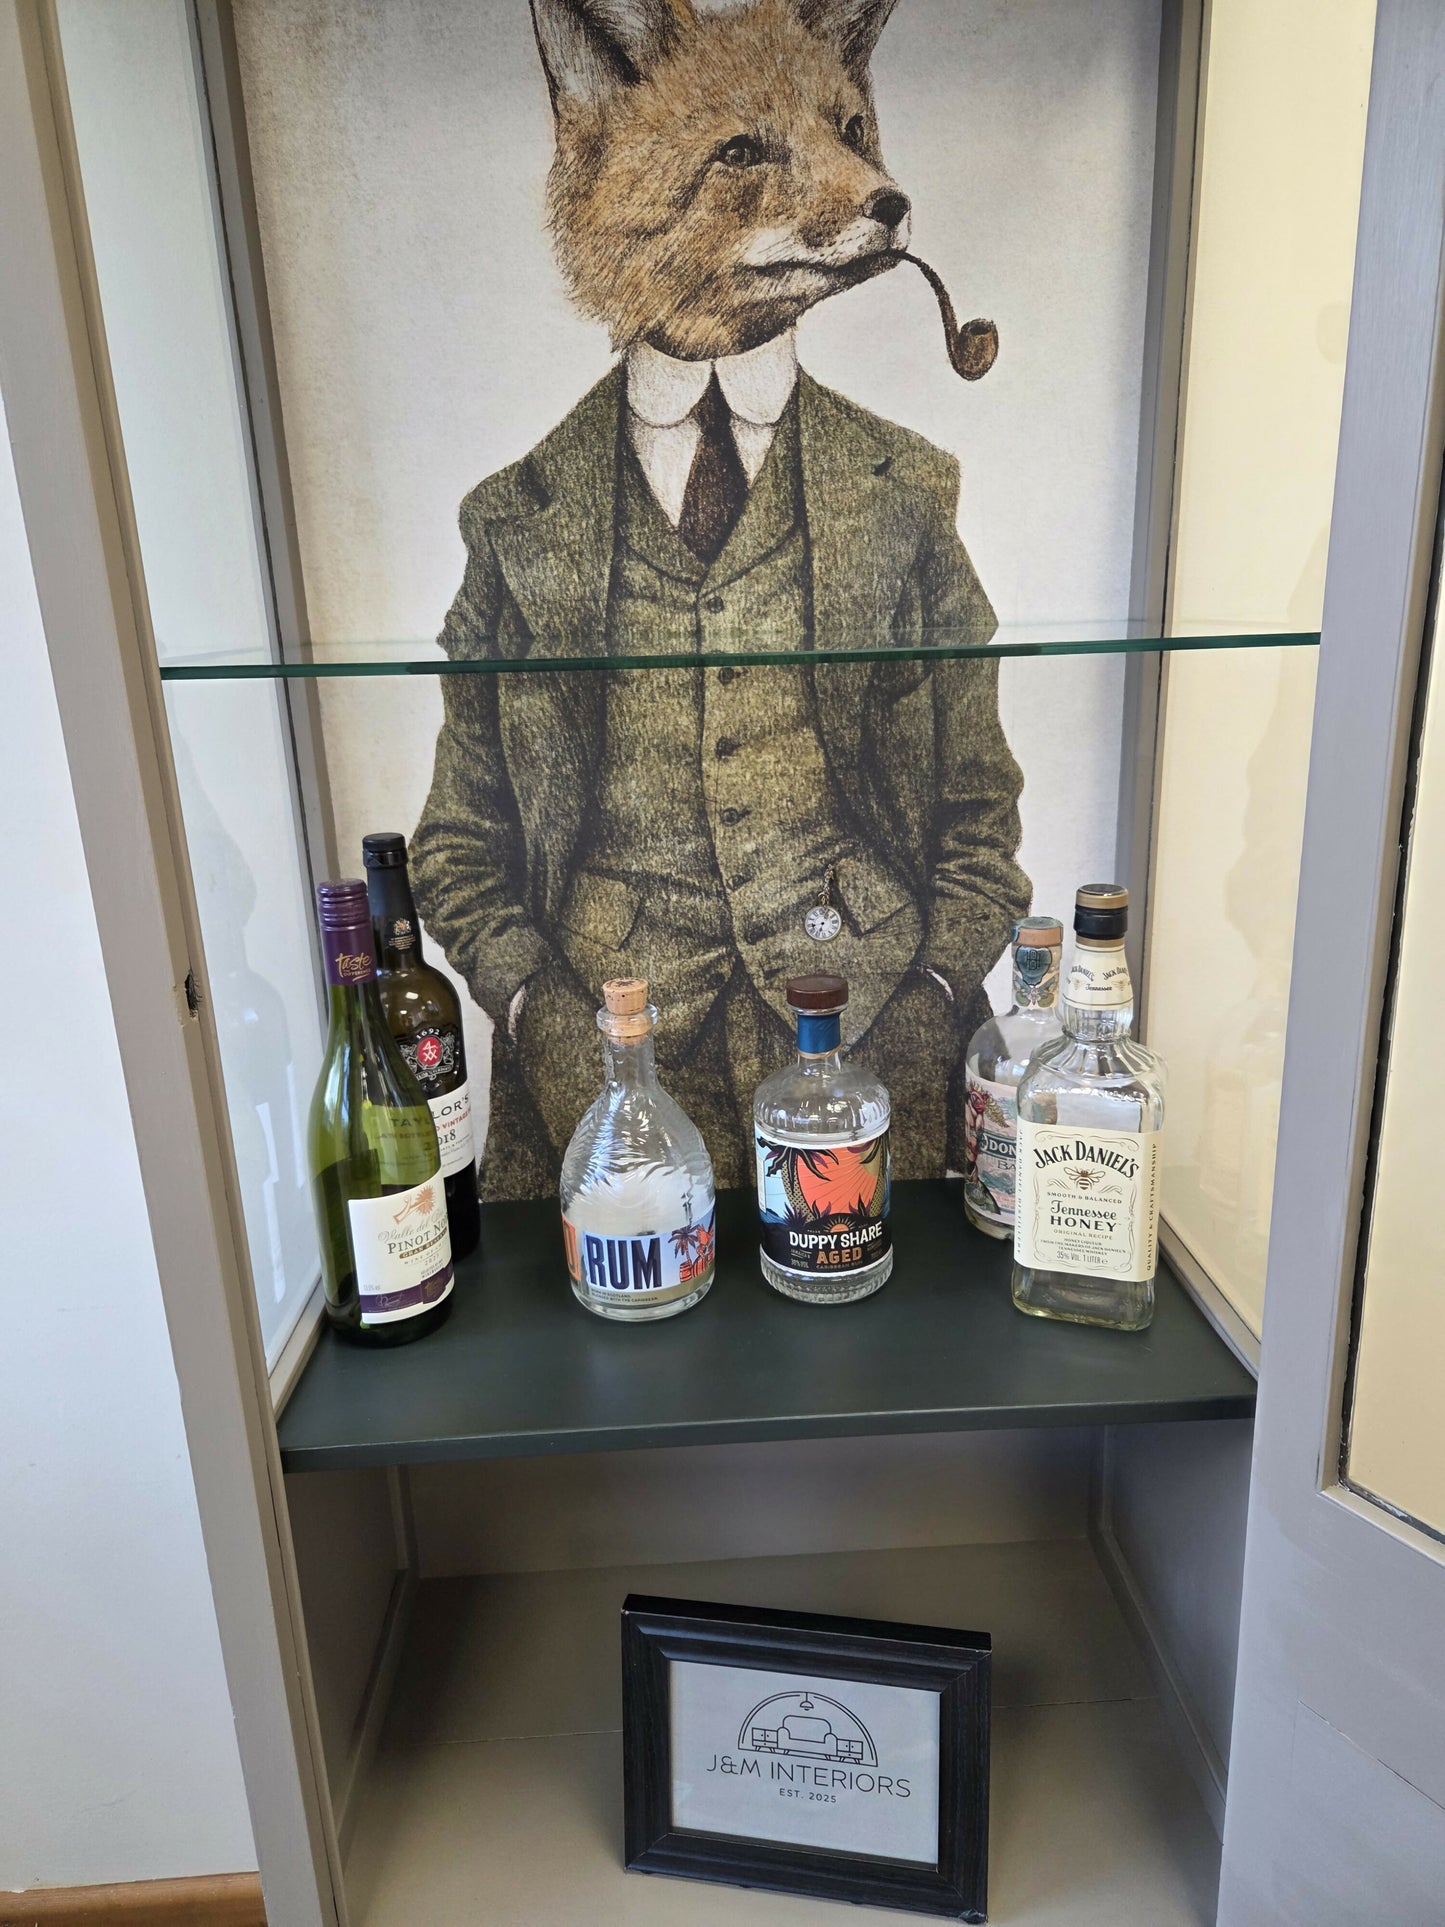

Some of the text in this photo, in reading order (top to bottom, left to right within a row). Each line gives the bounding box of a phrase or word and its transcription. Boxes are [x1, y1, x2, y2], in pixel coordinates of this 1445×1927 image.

[335, 952, 372, 978] taste
[416, 1028, 440, 1039] 1692
[1033, 1140, 1140, 1179] JACK DANIEL'S
[1148, 1143, 1157, 1221] CRAFTSMANSHIP
[1050, 1199, 1117, 1220] Tennessee
[1085, 1196, 1122, 1204] BALANCED
[1050, 1215, 1117, 1232] HONEY
[1053, 1228, 1086, 1237] ORIGINAL
[387, 1231, 430, 1254] PINOT
[789, 1231, 838, 1249] DUPPY
[840, 1220, 882, 1247] SHARE
[586, 1234, 662, 1290] RUM
[816, 1246, 862, 1264] AGED
[1056, 1250, 1070, 1260] 35%
[706, 1754, 911, 1798] J&M INTERIORS
[779, 1787, 837, 1803] EST. 2025
